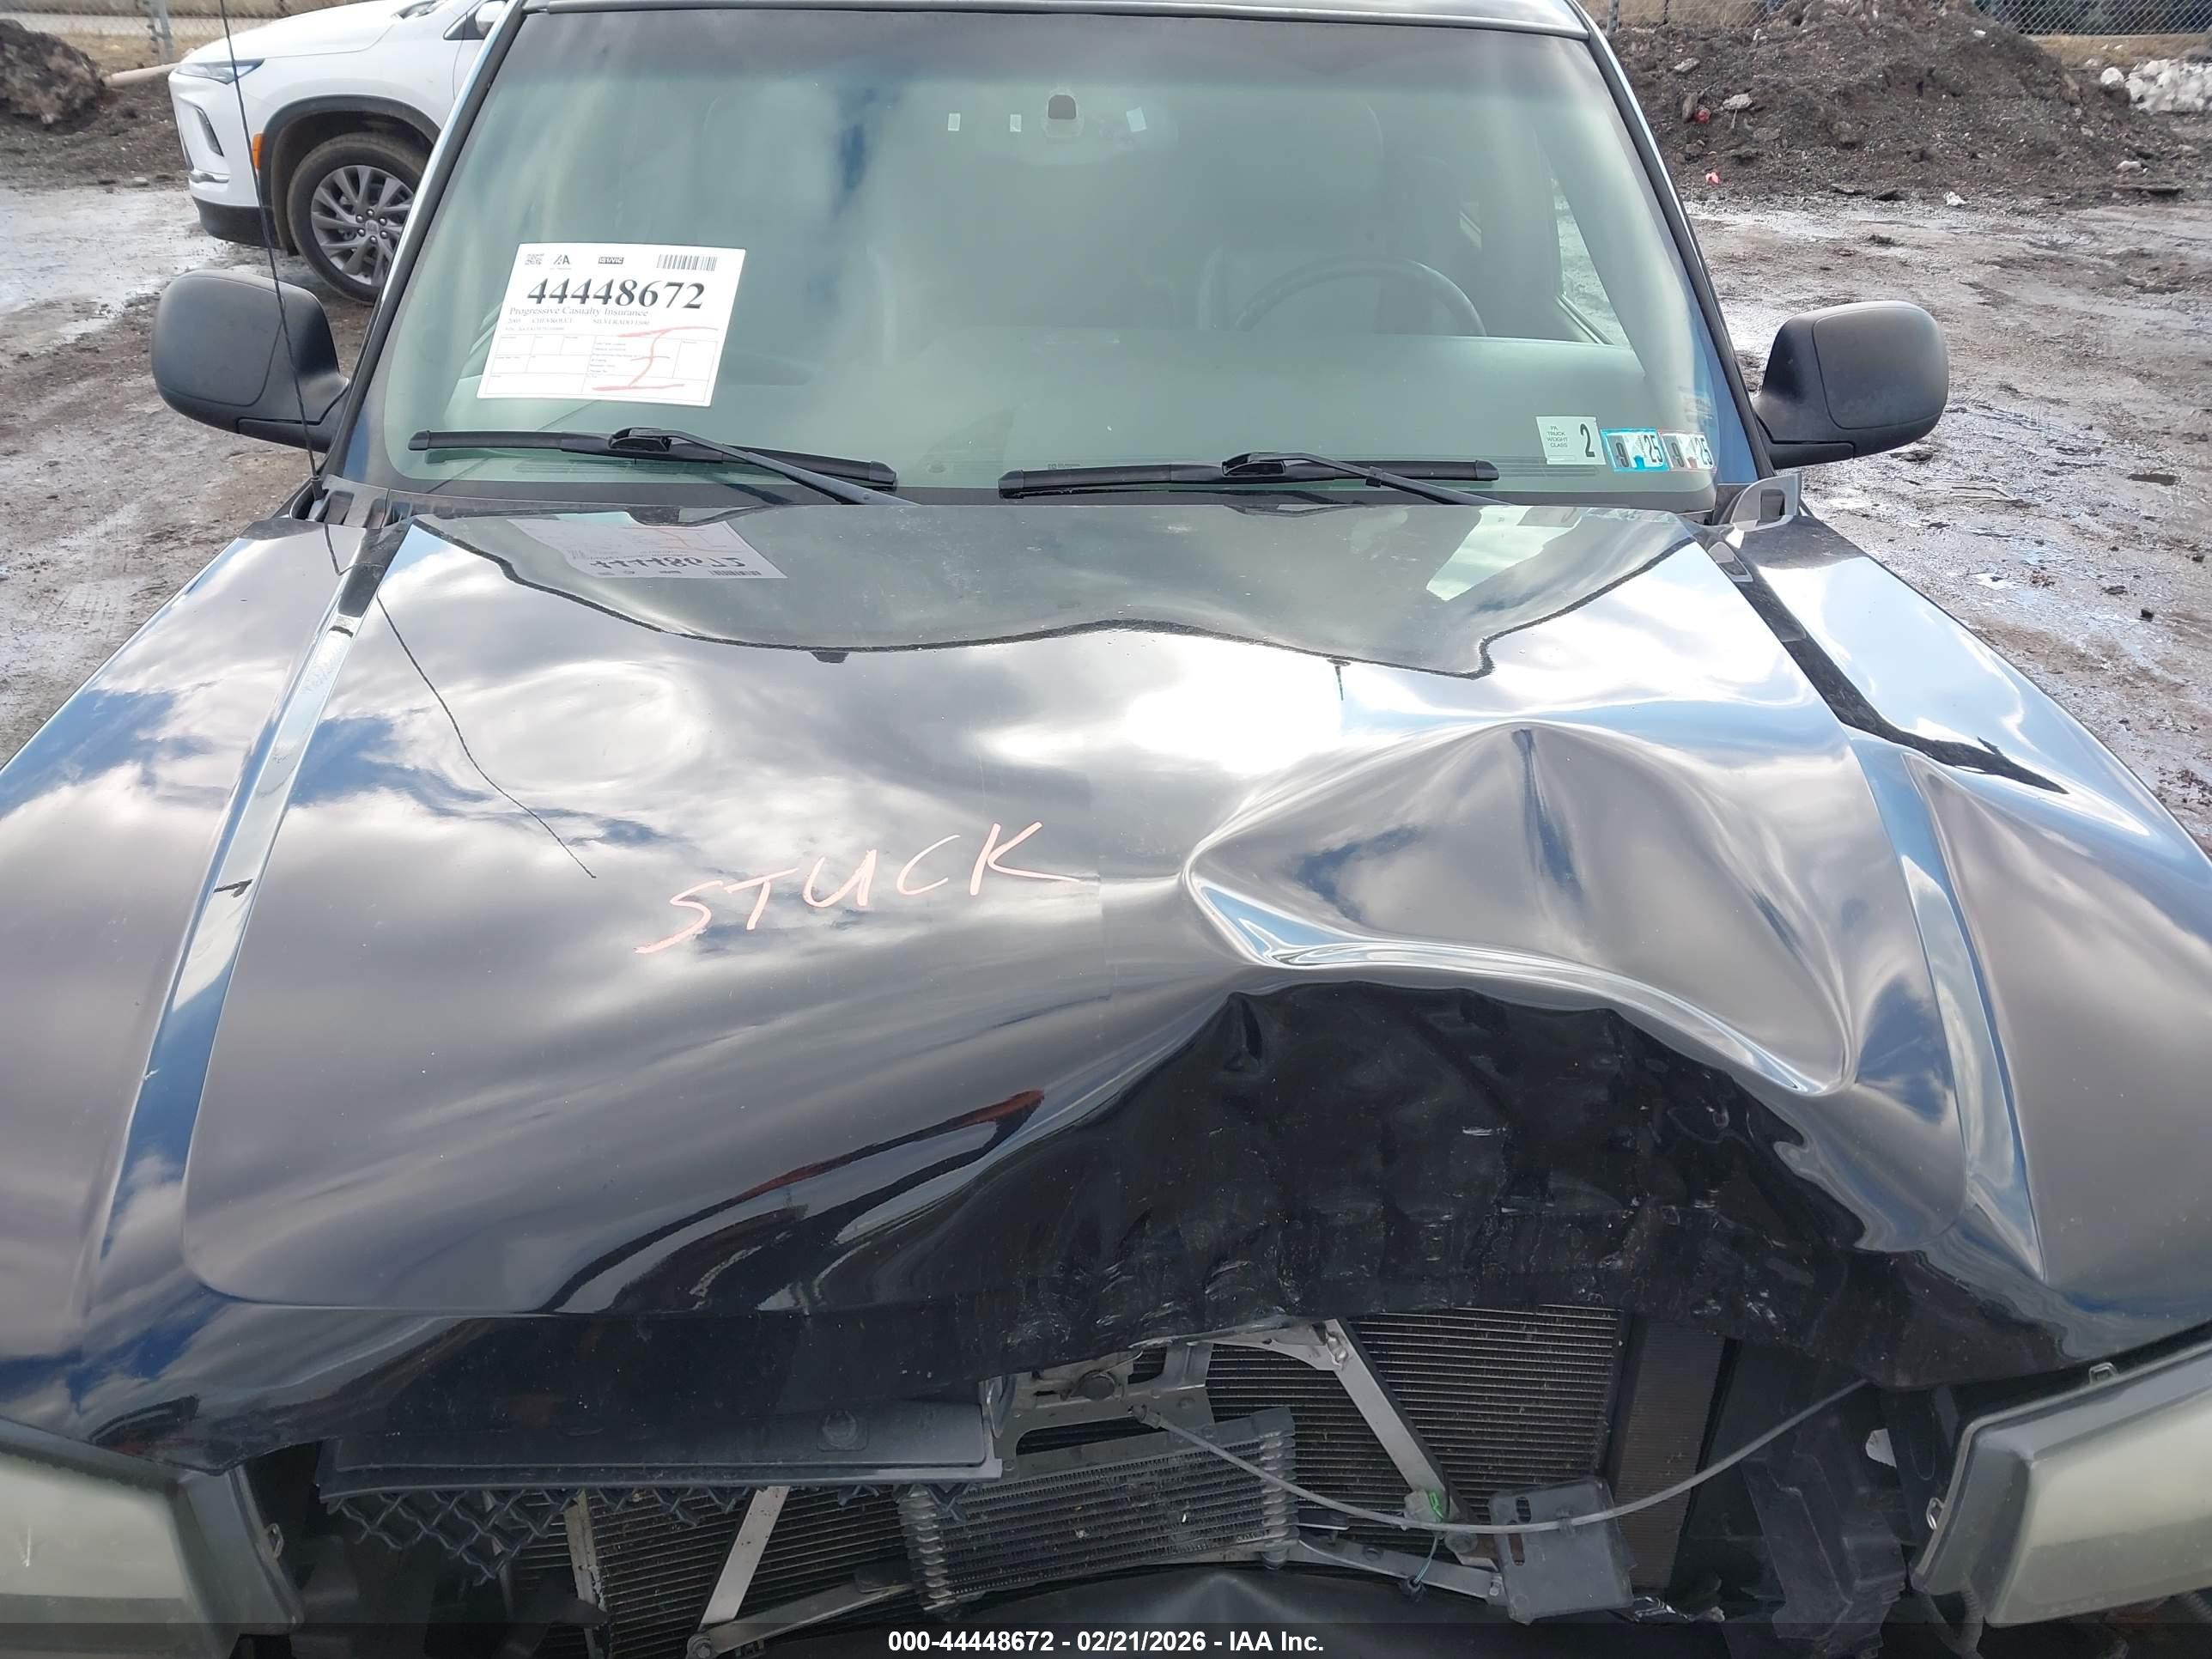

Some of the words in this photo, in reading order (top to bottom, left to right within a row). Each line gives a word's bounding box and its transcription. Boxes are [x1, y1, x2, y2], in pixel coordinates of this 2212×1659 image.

[527, 276, 706, 310] 44448672
[509, 307, 560, 317] Progressive
[562, 307, 600, 317] Casualty
[605, 307, 649, 317] Insurance
[1580, 423, 1595, 458] 2
[1615, 442, 1630, 468] 9
[1644, 434, 1663, 464] 25
[1671, 442, 1685, 468] 9
[1695, 437, 1713, 465] 25
[633, 821, 1080, 954] STUCK
